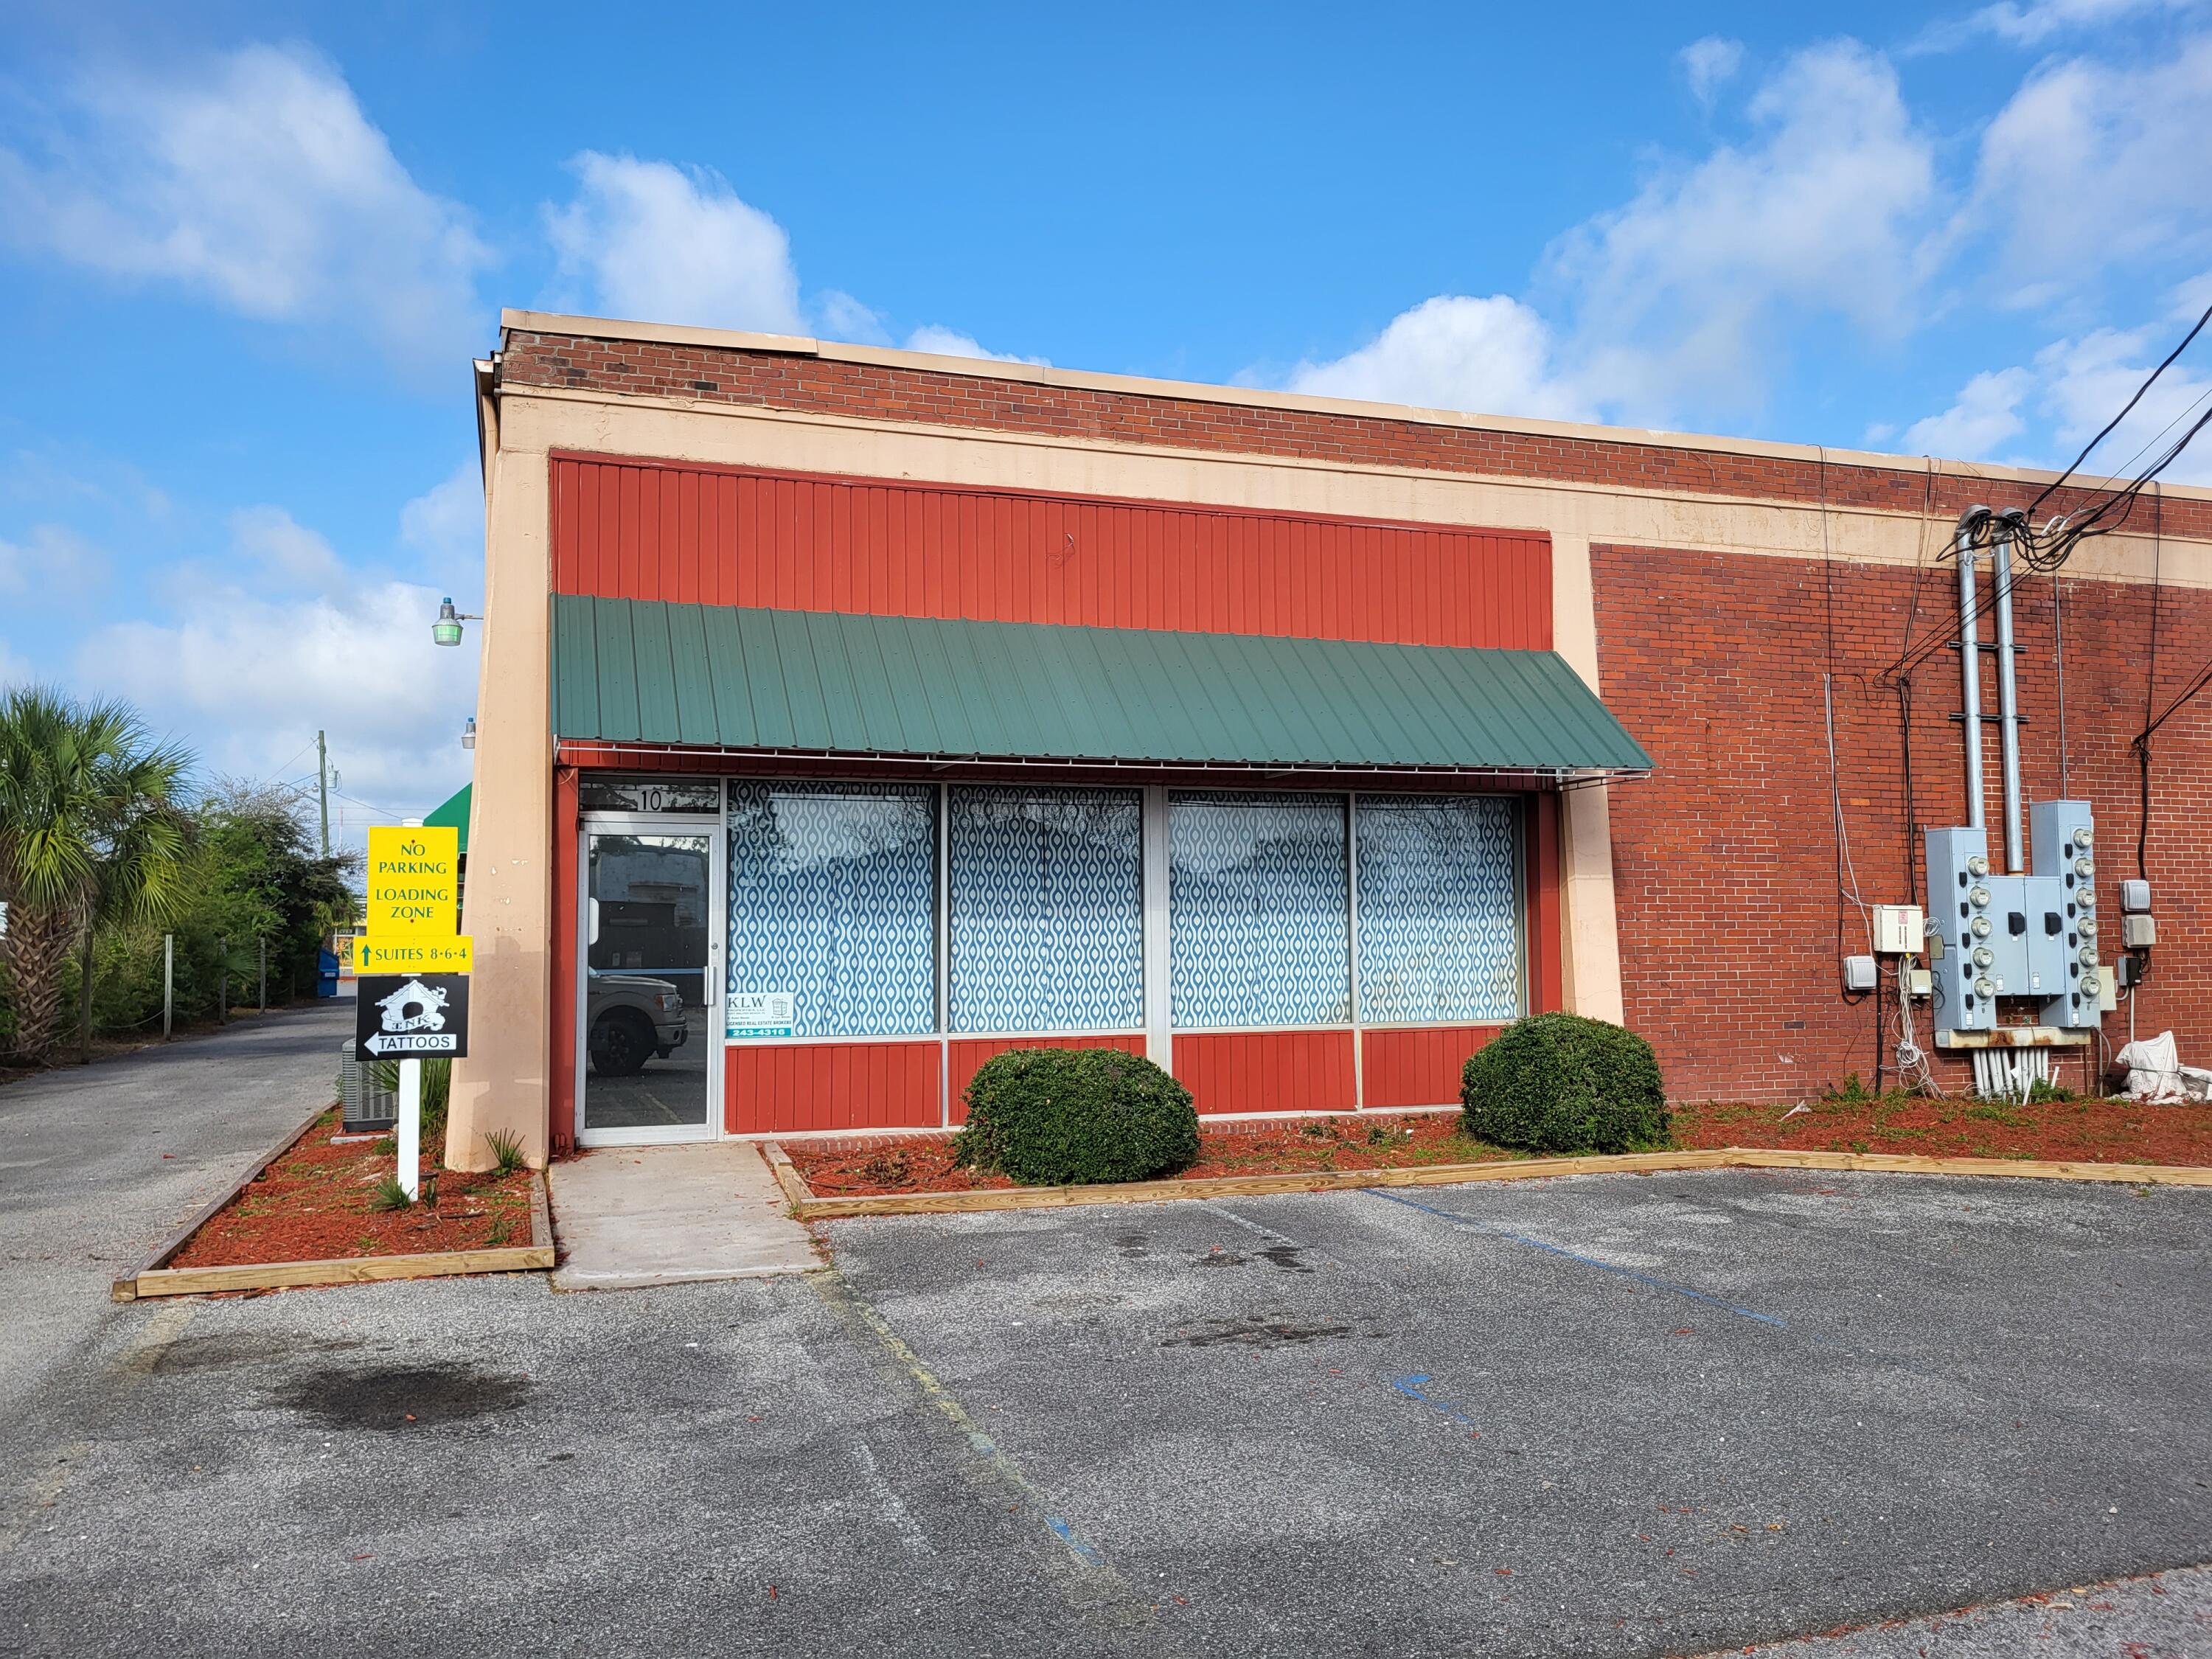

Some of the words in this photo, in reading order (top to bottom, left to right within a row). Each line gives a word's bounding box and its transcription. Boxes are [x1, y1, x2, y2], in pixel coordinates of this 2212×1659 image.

[641, 790, 661, 810] 10
[401, 844, 425, 856] NO
[378, 861, 447, 874] PARKING
[376, 888, 448, 901] LOADING
[390, 906, 434, 918] ZONE
[375, 947, 423, 961] SUITES
[728, 994, 767, 1008] KLW
[392, 1015, 431, 1029] INK
[378, 1036, 450, 1049] TATTOOS
